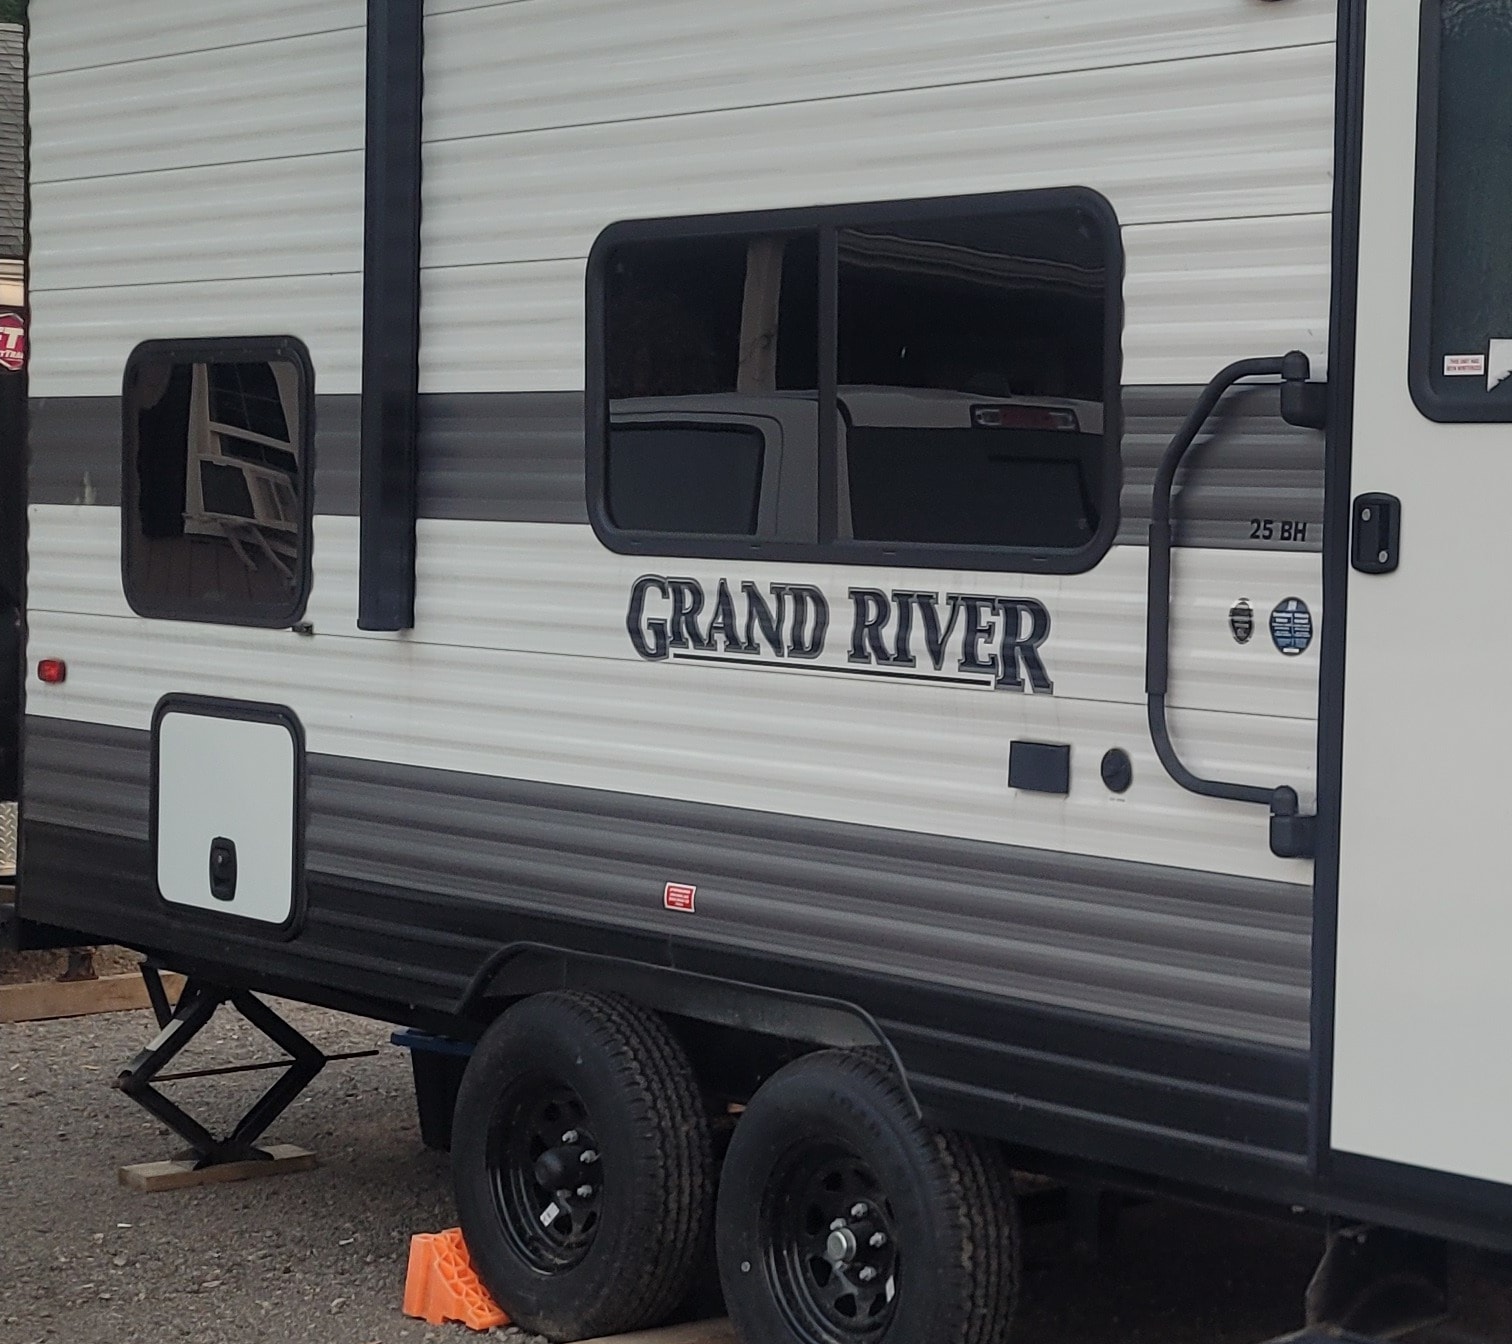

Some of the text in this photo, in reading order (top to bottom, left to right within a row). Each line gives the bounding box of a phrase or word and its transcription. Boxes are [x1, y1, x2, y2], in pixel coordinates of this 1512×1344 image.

[1249, 518, 1307, 542] 25 BH
[626, 573, 1054, 695] GRAND RIVER
